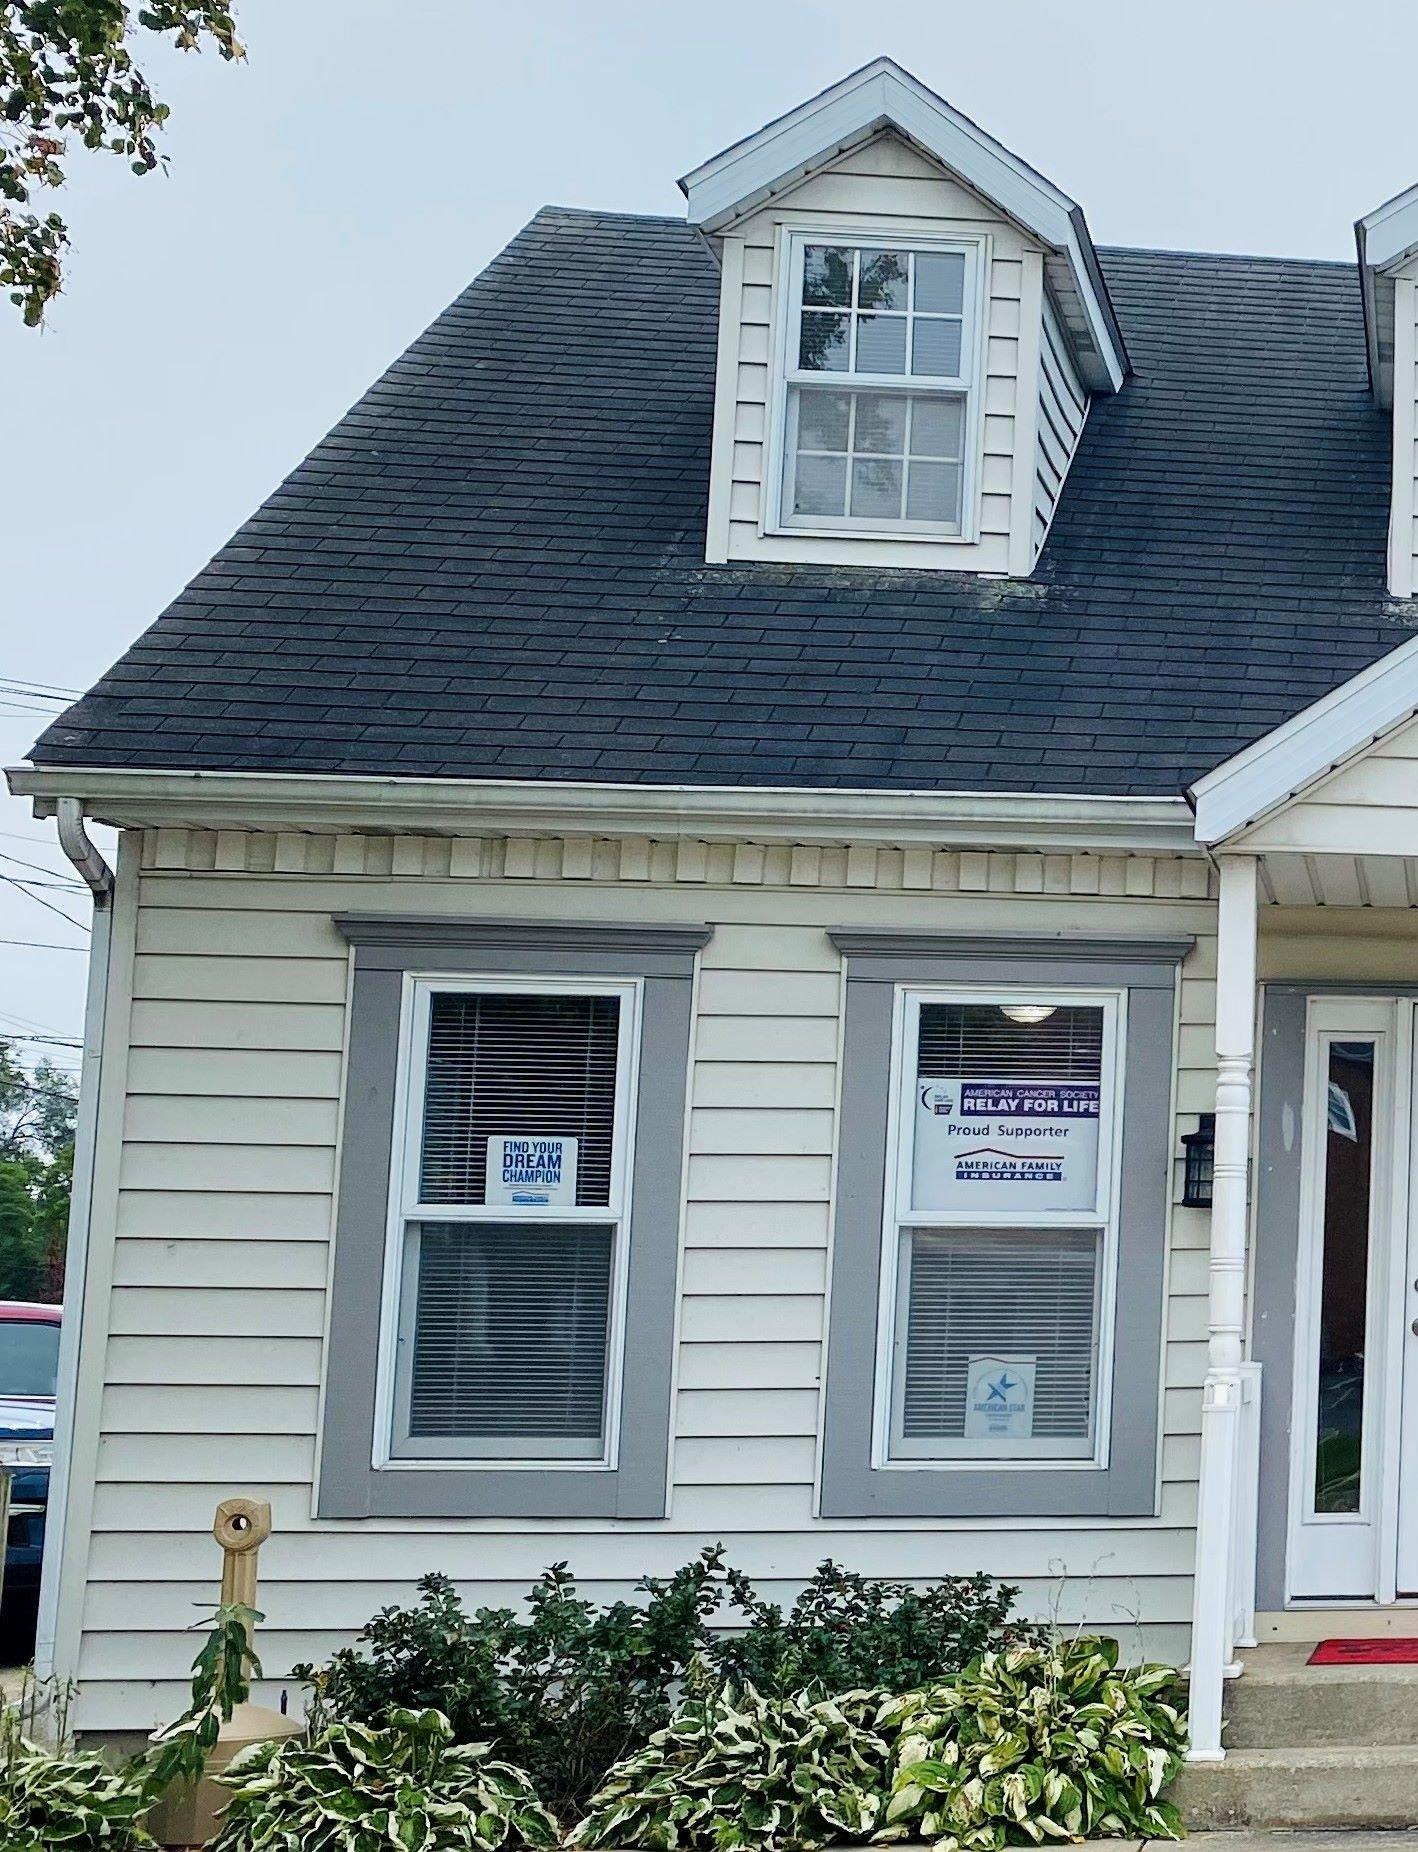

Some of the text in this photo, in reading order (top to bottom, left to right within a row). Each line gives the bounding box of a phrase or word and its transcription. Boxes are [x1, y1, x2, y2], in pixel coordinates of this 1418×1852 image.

[964, 1089, 1099, 1100] AMERICAN CANCER SOCIETY
[963, 1098, 1020, 1111] RELAY
[1023, 1099, 1059, 1112] FOR
[1062, 1100, 1100, 1113] LIFE
[947, 1124, 1070, 1139] Proud Supporter
[503, 1141, 563, 1154] FIND YOUR
[502, 1153, 562, 1169] DREAM
[956, 1161, 1063, 1171] AMERICAN FAMILY
[502, 1169, 561, 1183] CHAMPION
[963, 1172, 1054, 1180] INSURANCE
